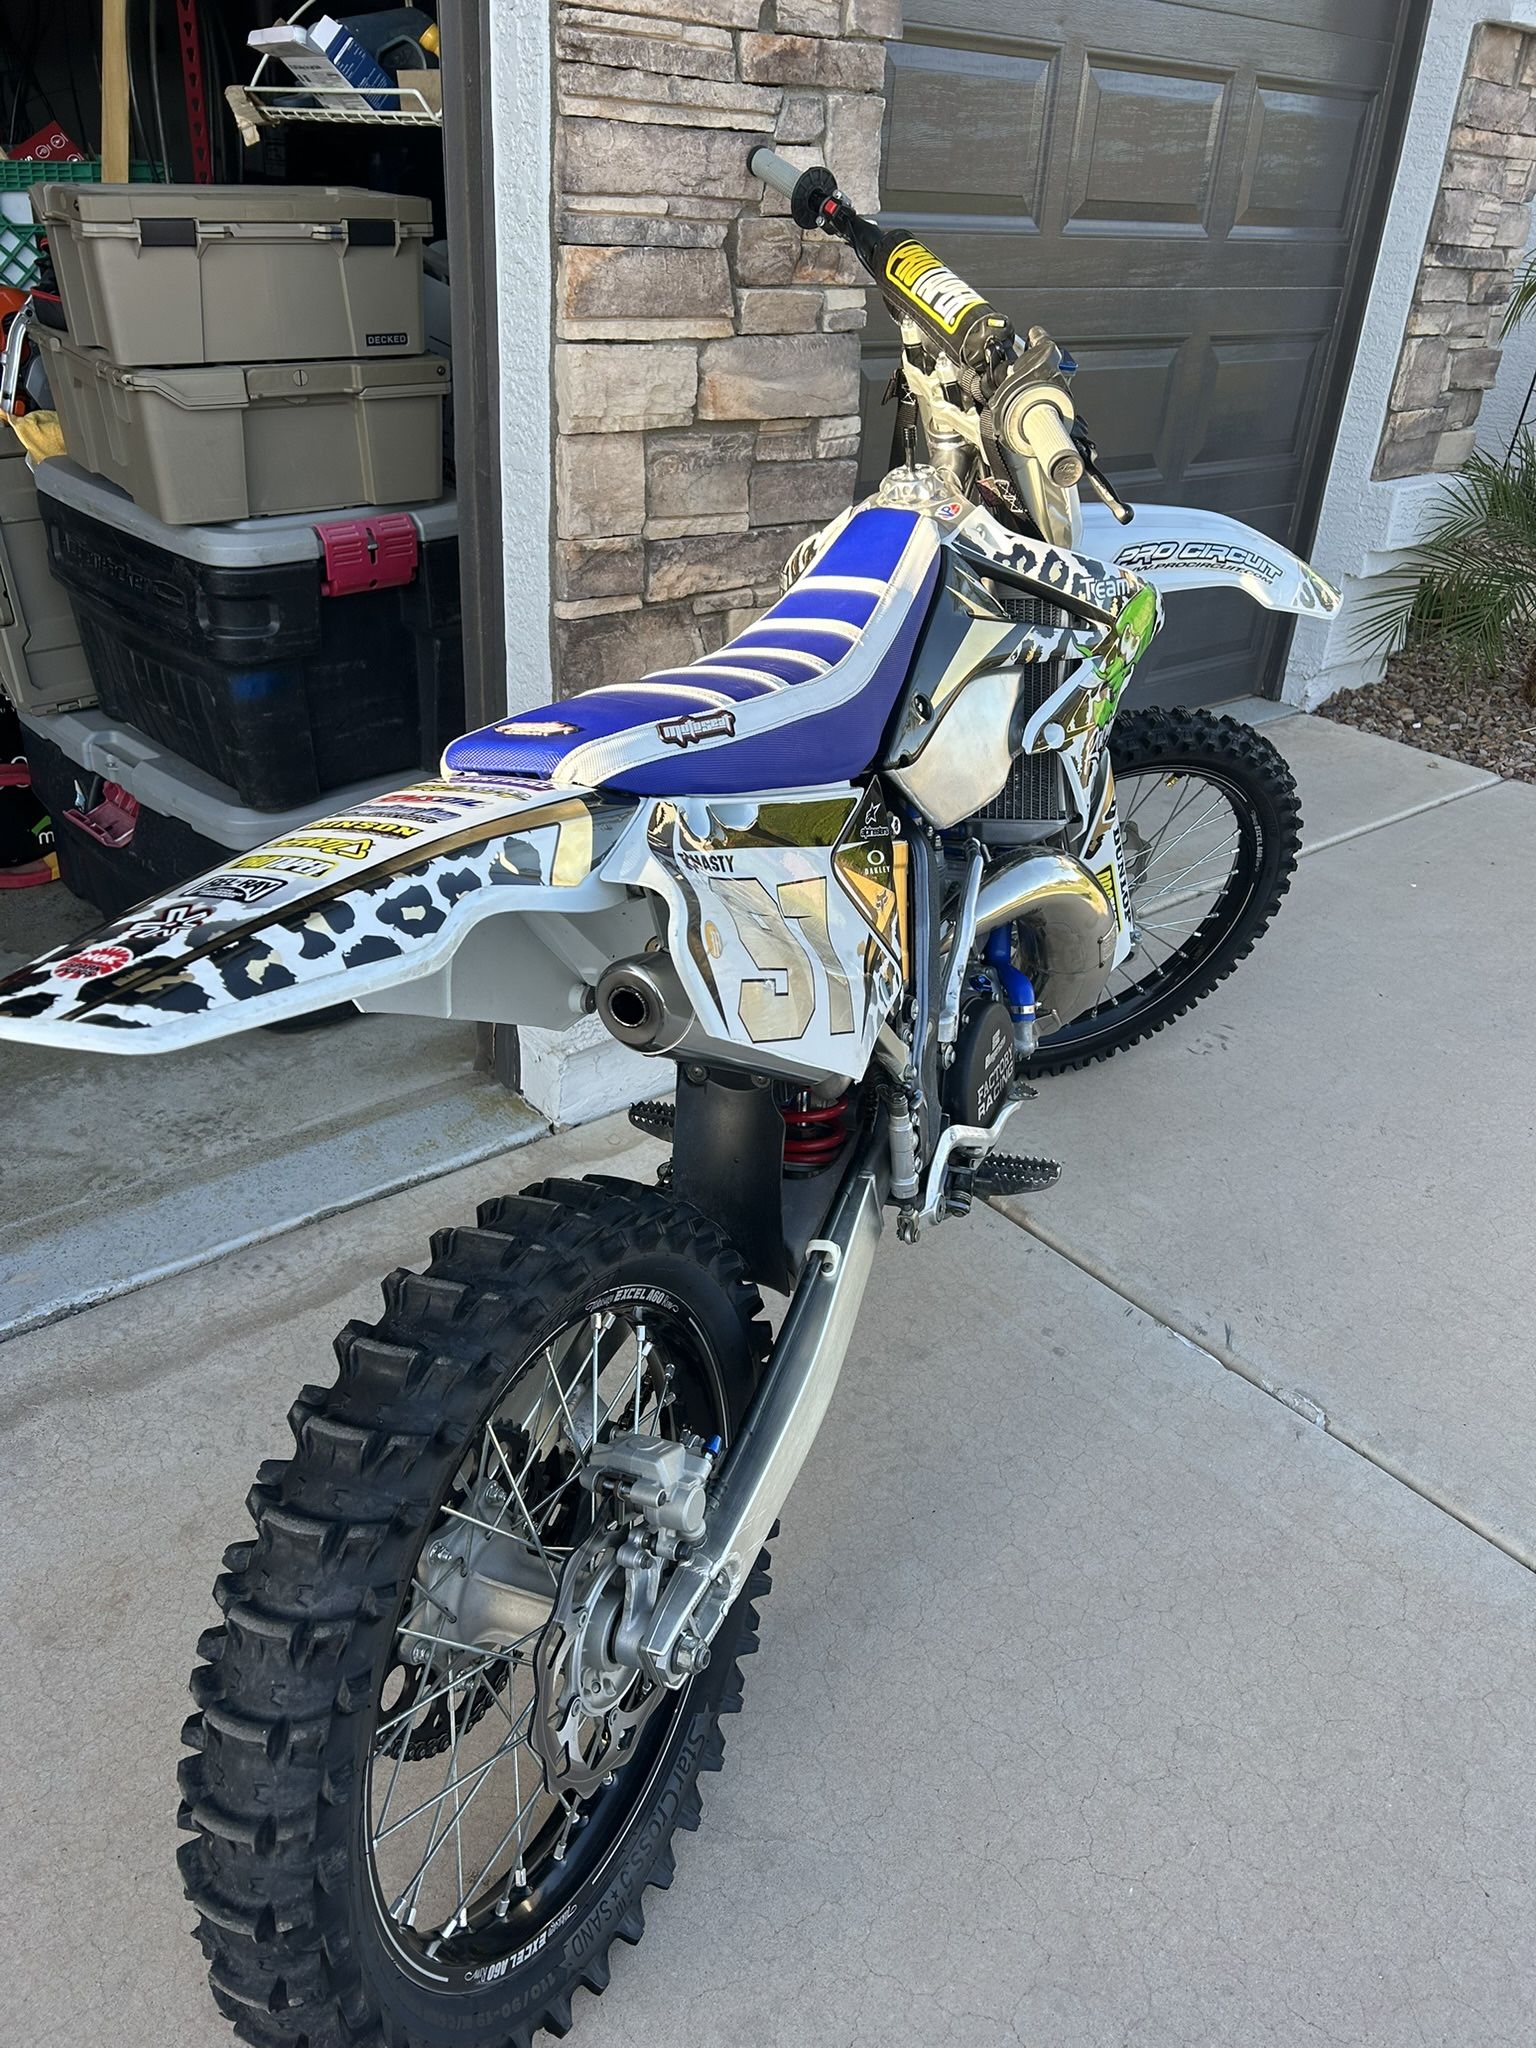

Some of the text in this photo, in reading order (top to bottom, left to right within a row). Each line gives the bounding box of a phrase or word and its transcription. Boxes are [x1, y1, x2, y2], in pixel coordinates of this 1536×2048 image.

[890, 244, 984, 326] PRO TAPER
[367, 334, 407, 345] DECKED
[1113, 541, 1284, 580] PRO CIRCUIT
[1131, 562, 1274, 585] W.PROCIRCUIT.COM
[1079, 576, 1131, 601] Team
[864, 866, 891, 876] OAKLEY
[1112, 827, 1134, 924] DUNLOP
[80, 952, 123, 965] NGK
[977, 1043, 1013, 1105] FACTORY
[977, 1061, 1014, 1121] RACING
[613, 1287, 647, 1302] EXCEL
[646, 1288, 665, 1304] A60
[571, 1897, 614, 1958] SAND
[509, 1930, 548, 1969] EXCEL
[486, 1957, 509, 1981] A60
